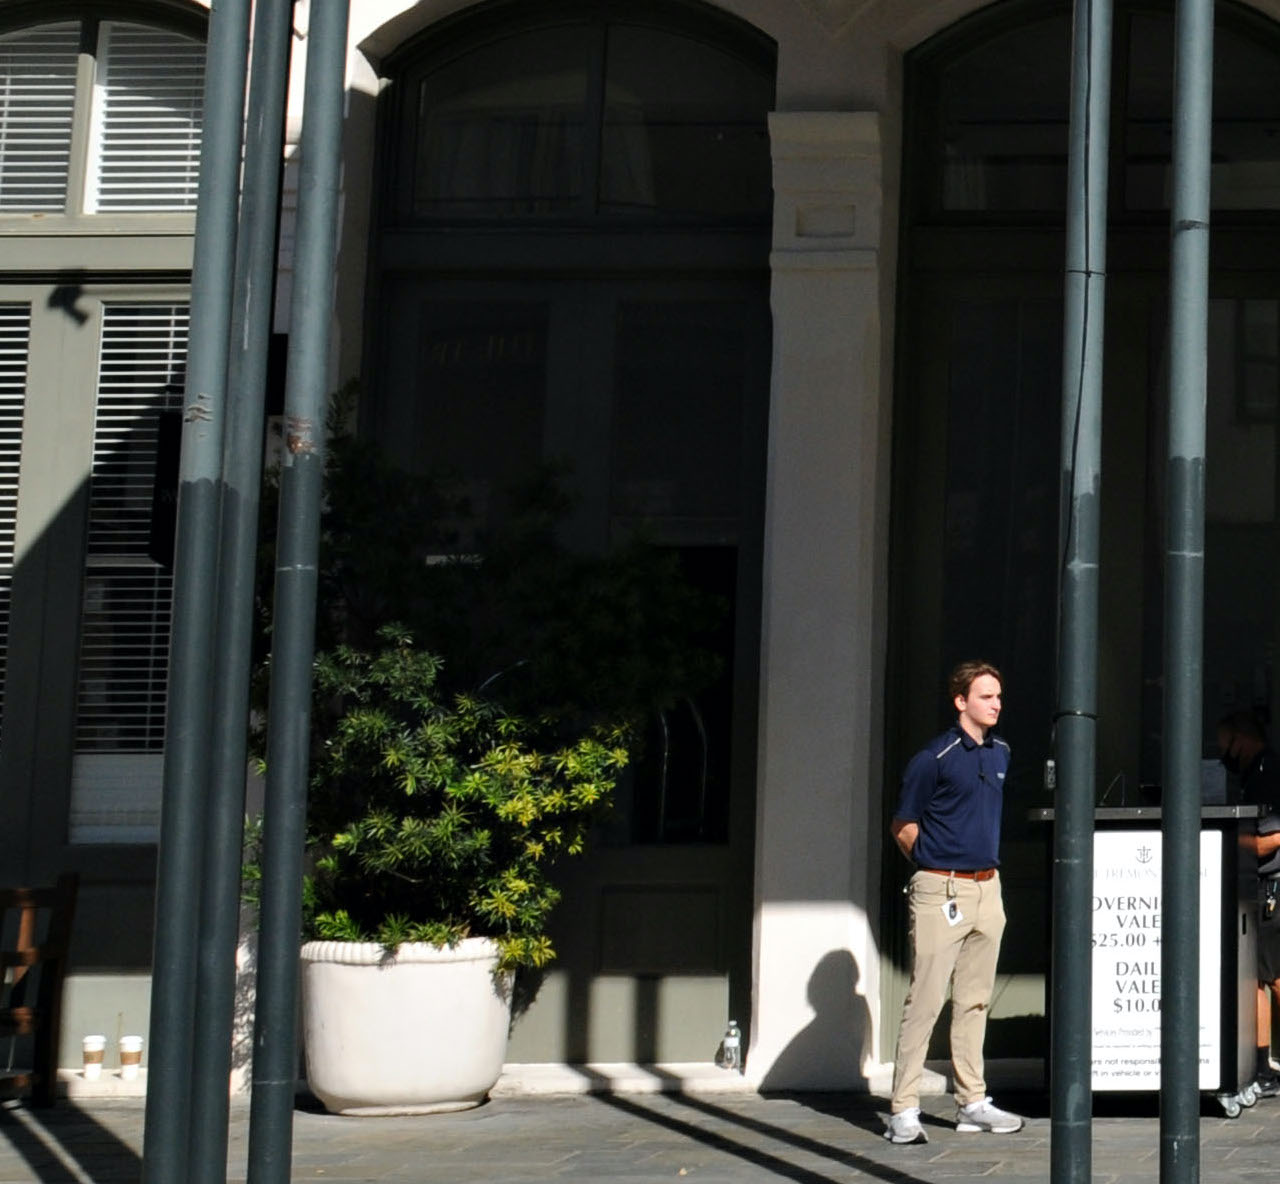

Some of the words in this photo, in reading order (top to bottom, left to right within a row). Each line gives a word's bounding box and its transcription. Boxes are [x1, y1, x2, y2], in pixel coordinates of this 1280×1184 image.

[1091, 896, 1158, 912] OVERNI
[1116, 914, 1161, 928] VALE
[1116, 961, 1159, 976] DAIL
[1115, 979, 1161, 994] VALE
[1113, 997, 1161, 1014] $10.0
[1120, 1058, 1159, 1067] responsi
